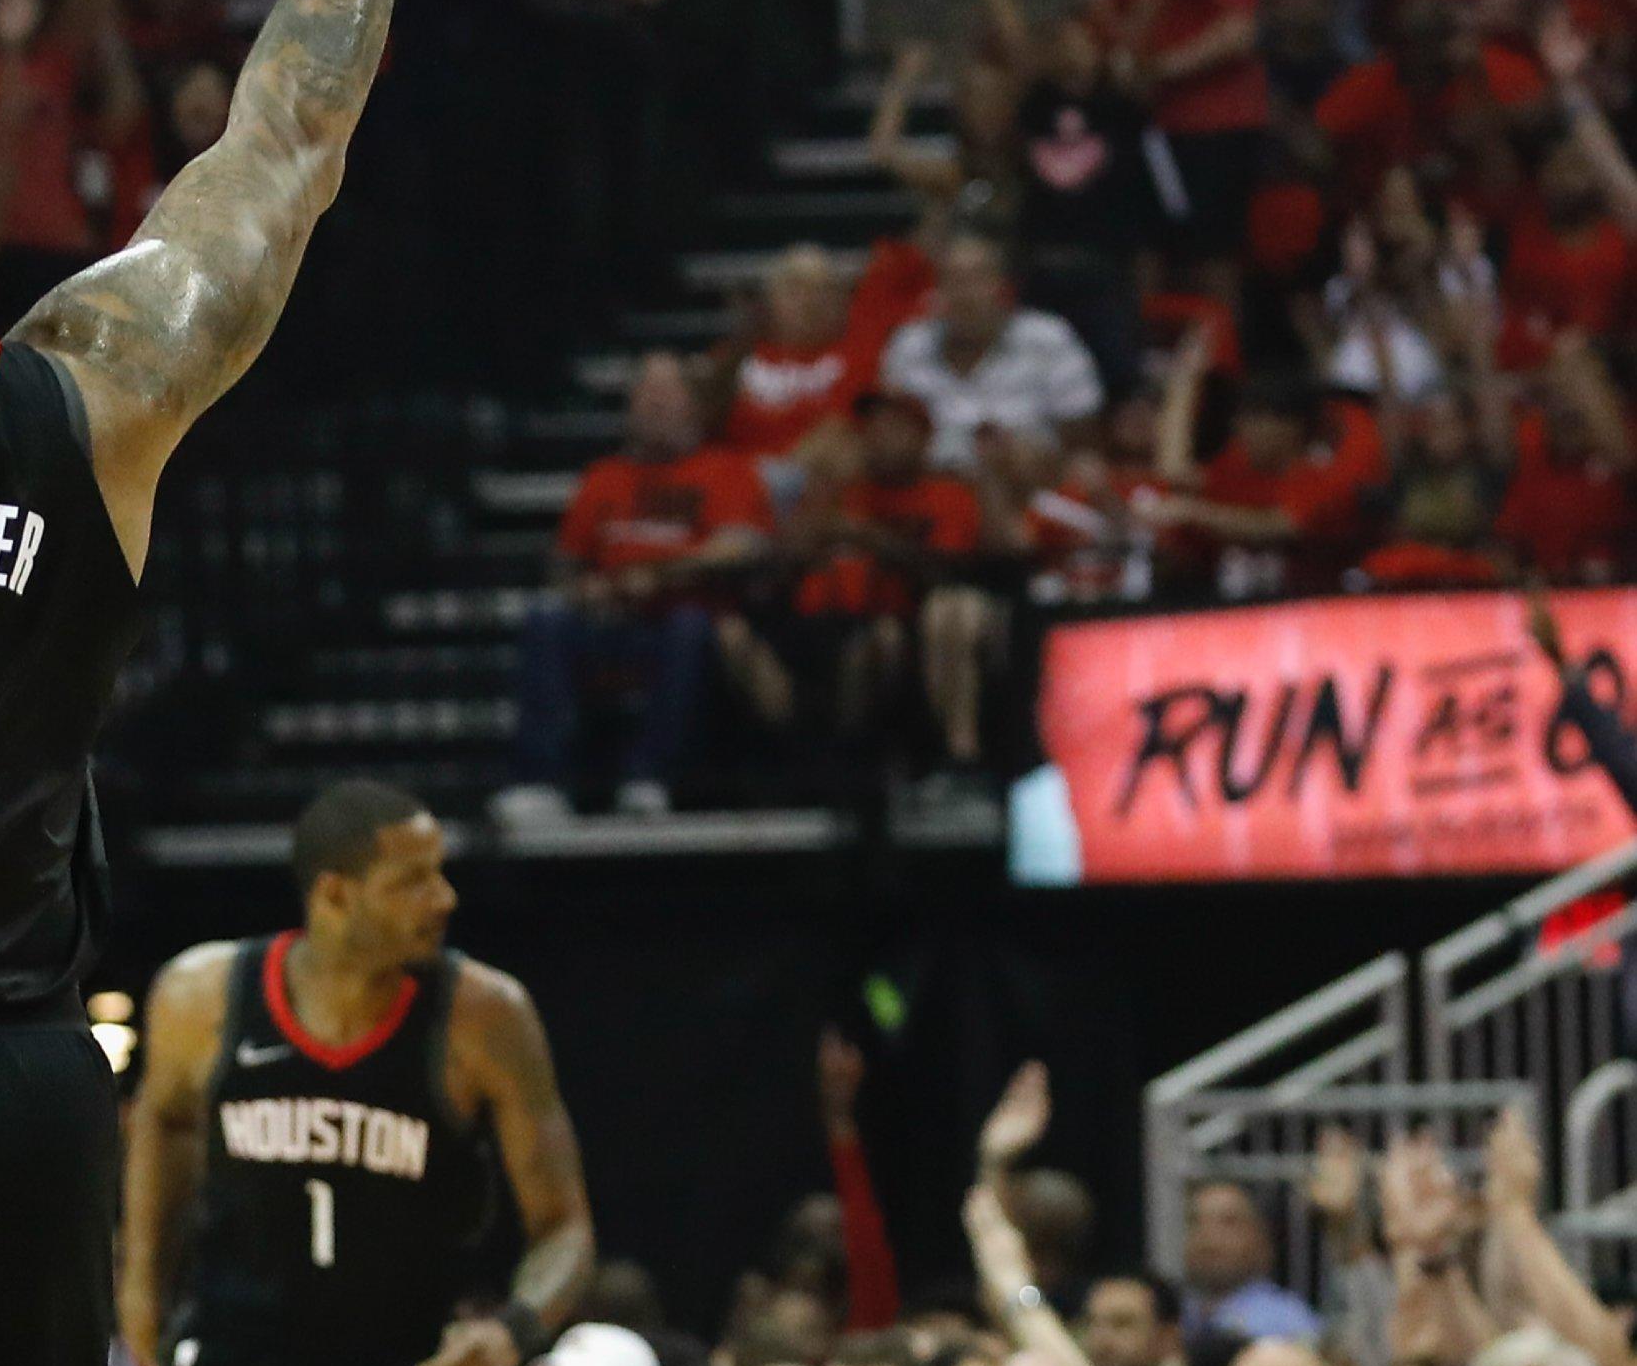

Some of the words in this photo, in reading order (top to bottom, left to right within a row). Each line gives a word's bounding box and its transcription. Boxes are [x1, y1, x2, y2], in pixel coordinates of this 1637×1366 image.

[1110, 658, 1396, 821] RUN
[219, 1097, 430, 1182] HOUSTON
[304, 1178, 336, 1268] 1
